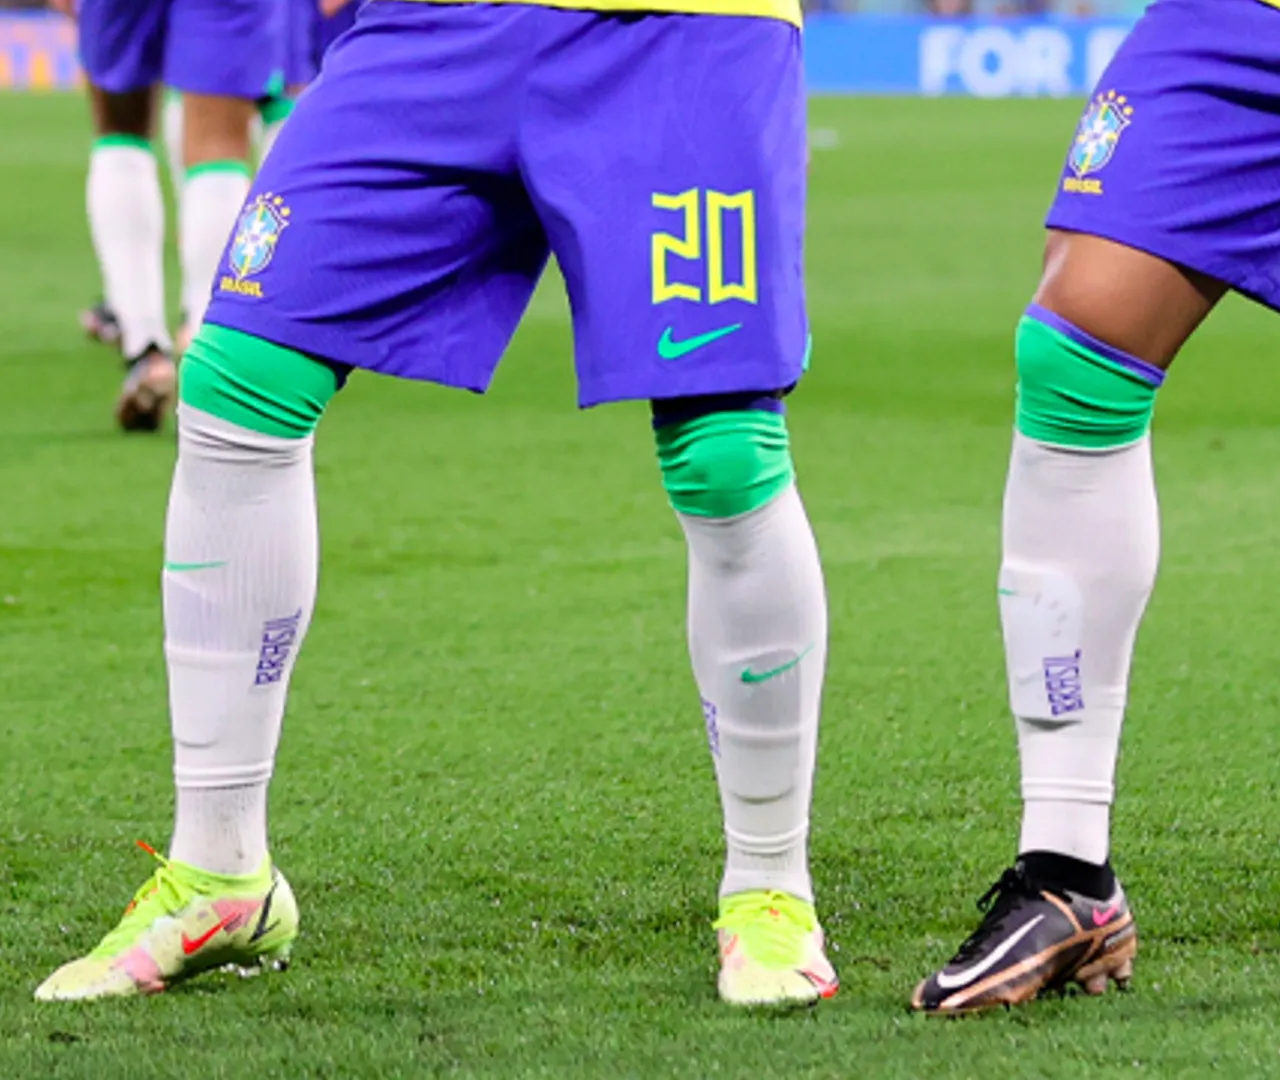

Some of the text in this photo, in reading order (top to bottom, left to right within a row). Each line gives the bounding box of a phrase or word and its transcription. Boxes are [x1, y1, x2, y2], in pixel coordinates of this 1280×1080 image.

[920, 24, 1074, 98] FOR
[651, 187, 758, 306] 20
[255, 607, 302, 685] BRASIL
[1042, 649, 1084, 716] BRASIL
